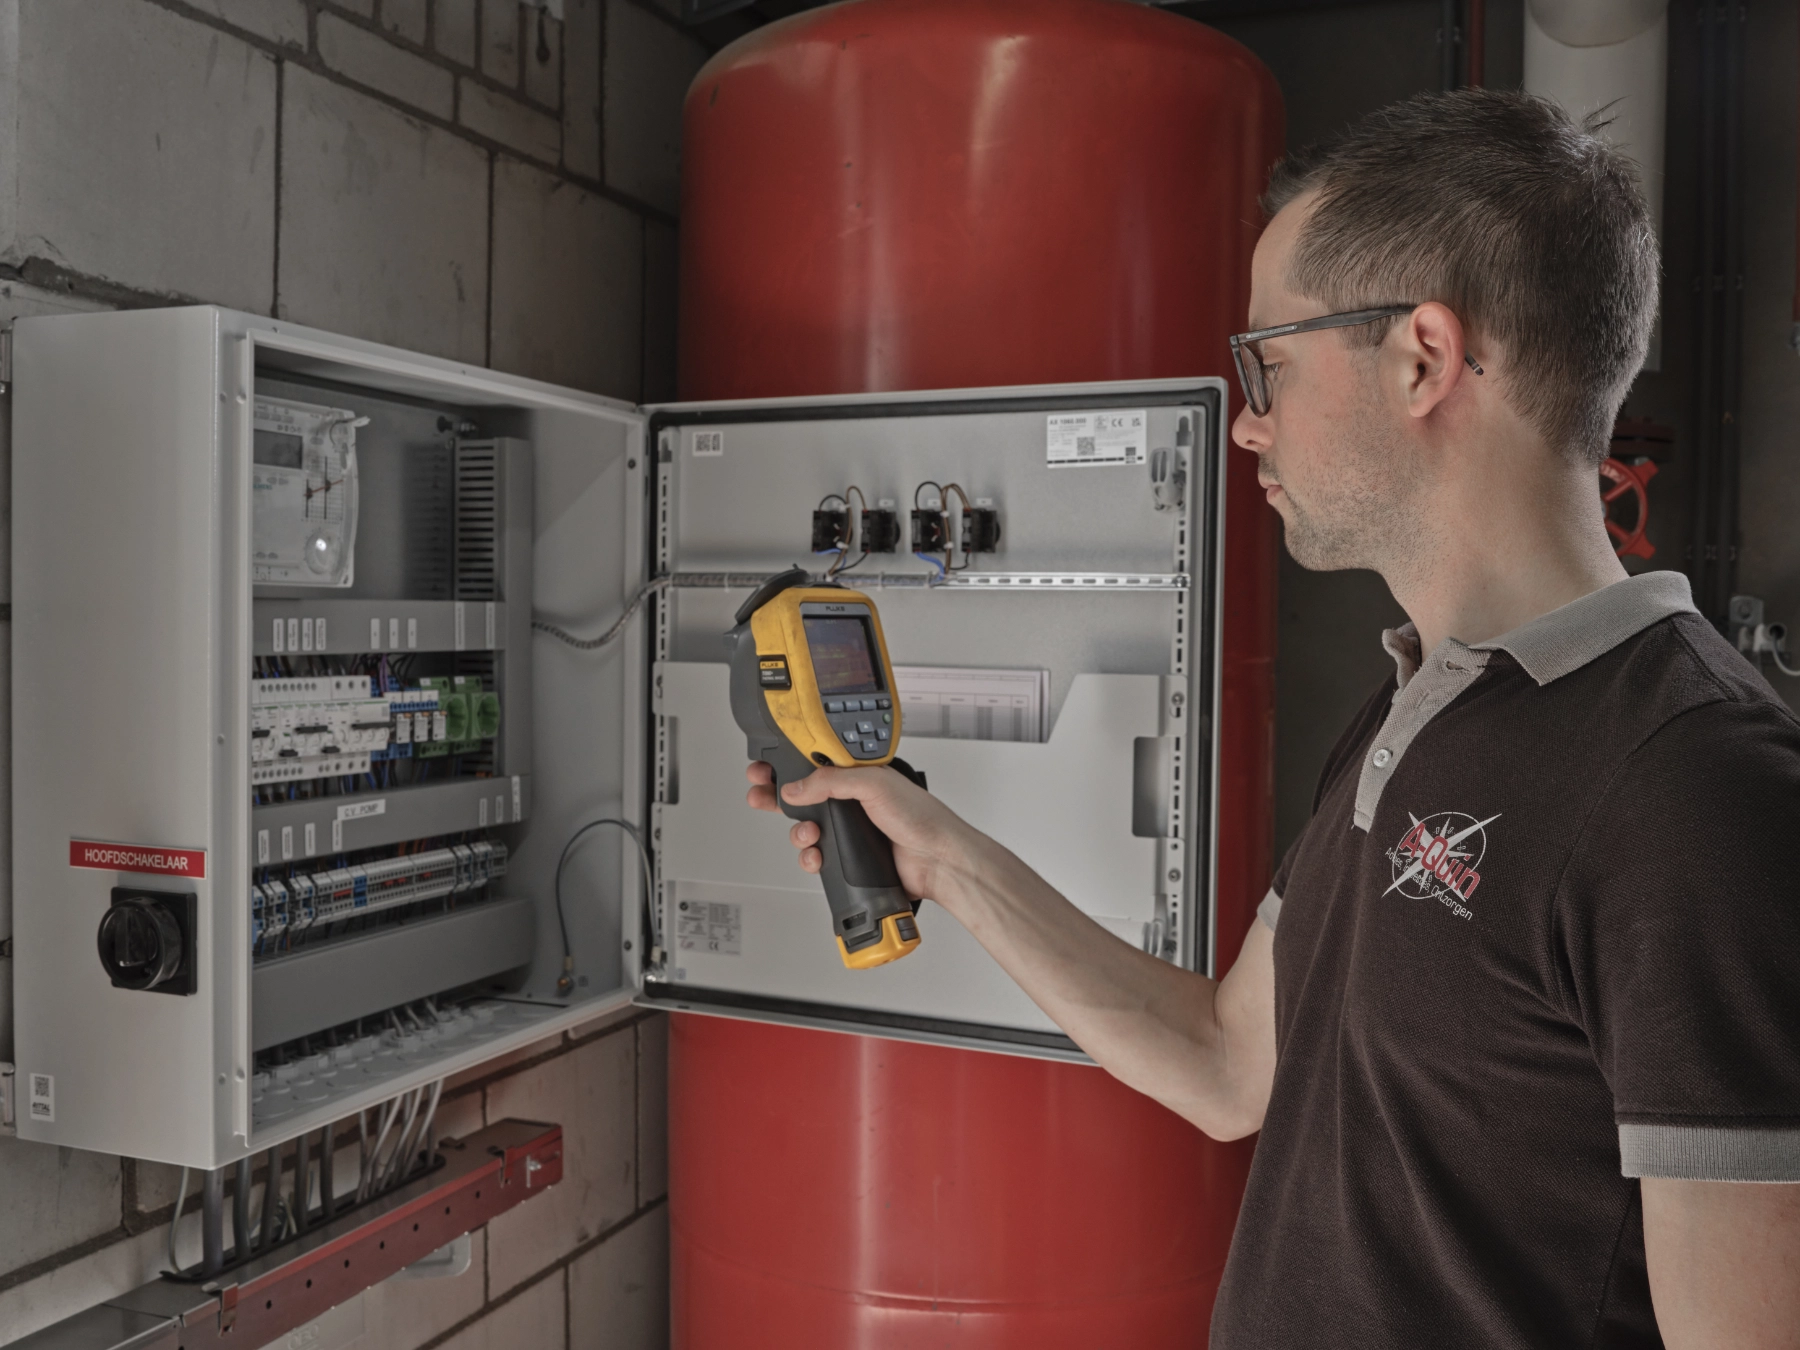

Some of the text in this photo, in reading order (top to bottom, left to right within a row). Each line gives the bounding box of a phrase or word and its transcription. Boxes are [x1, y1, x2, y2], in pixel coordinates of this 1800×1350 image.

[85, 849, 188, 871] HOOFDSCHAKELAAR
[1399, 822, 1481, 900] A-Quin
[1431, 885, 1473, 920] Ontzorgen
